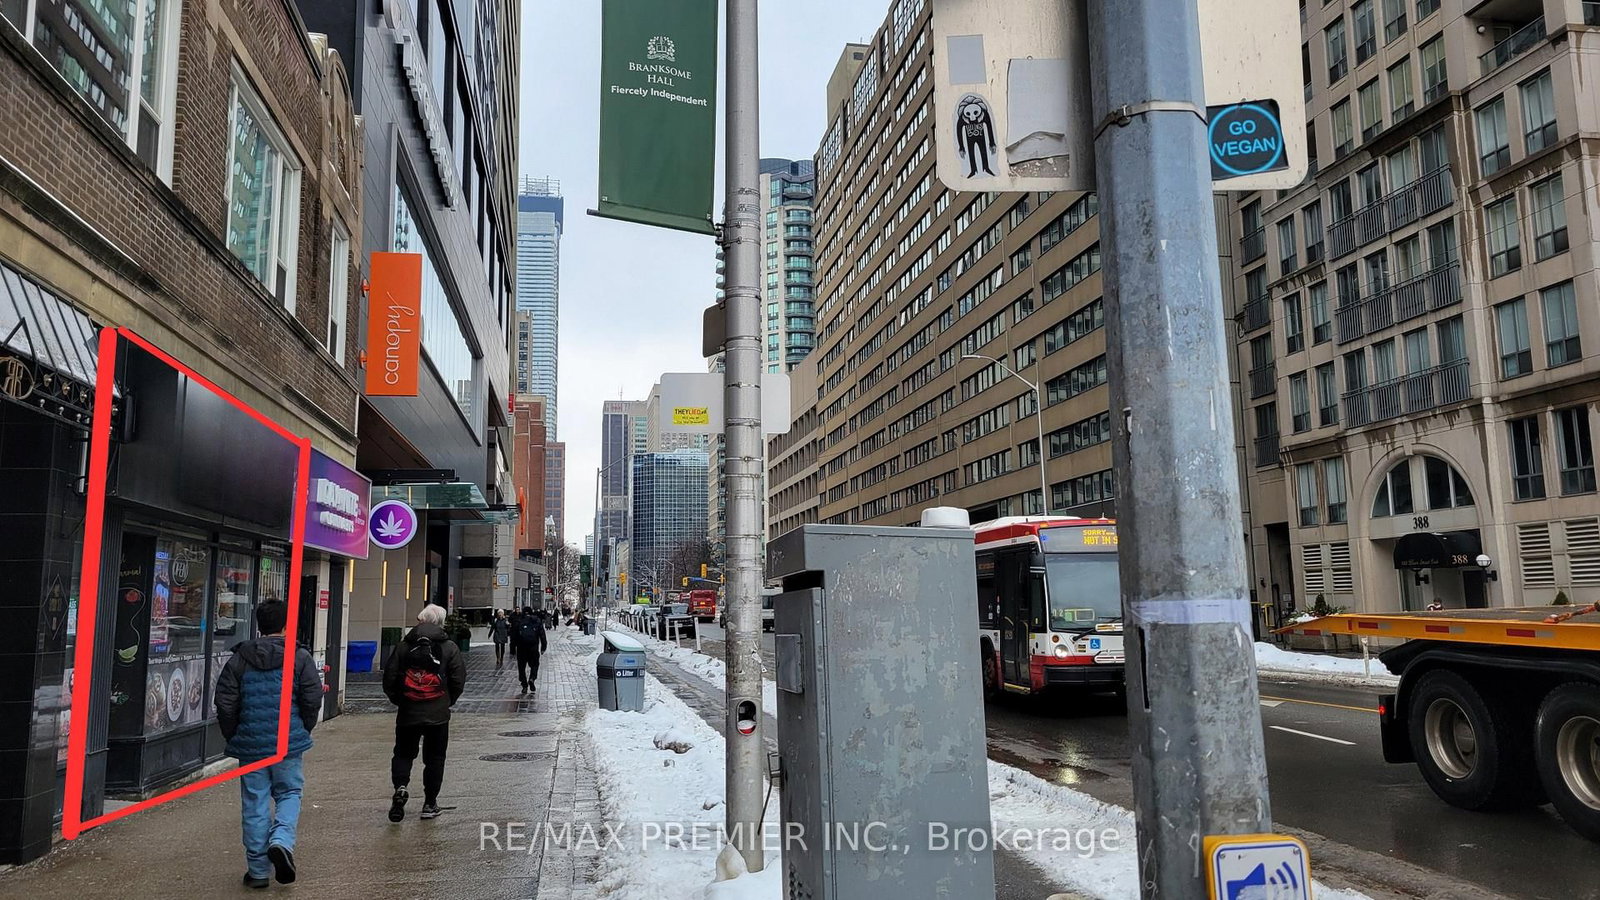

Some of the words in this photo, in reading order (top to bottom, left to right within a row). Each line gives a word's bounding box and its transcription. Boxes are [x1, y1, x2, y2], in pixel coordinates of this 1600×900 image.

[629, 62, 692, 79] BRANKSOME
[647, 74, 675, 87] HALL
[611, 85, 648, 97] Fiercely
[650, 88, 708, 106] Independent
[1229, 120, 1256, 135] GO
[1214, 137, 1276, 157] VEGAN
[385, 291, 415, 384] canopy
[1413, 516, 1429, 529] 388
[1083, 536, 1099, 545] NOT
[1102, 536, 1111, 545] IN
[1452, 554, 1468, 564] 388
[622, 669, 634, 677] Litter
